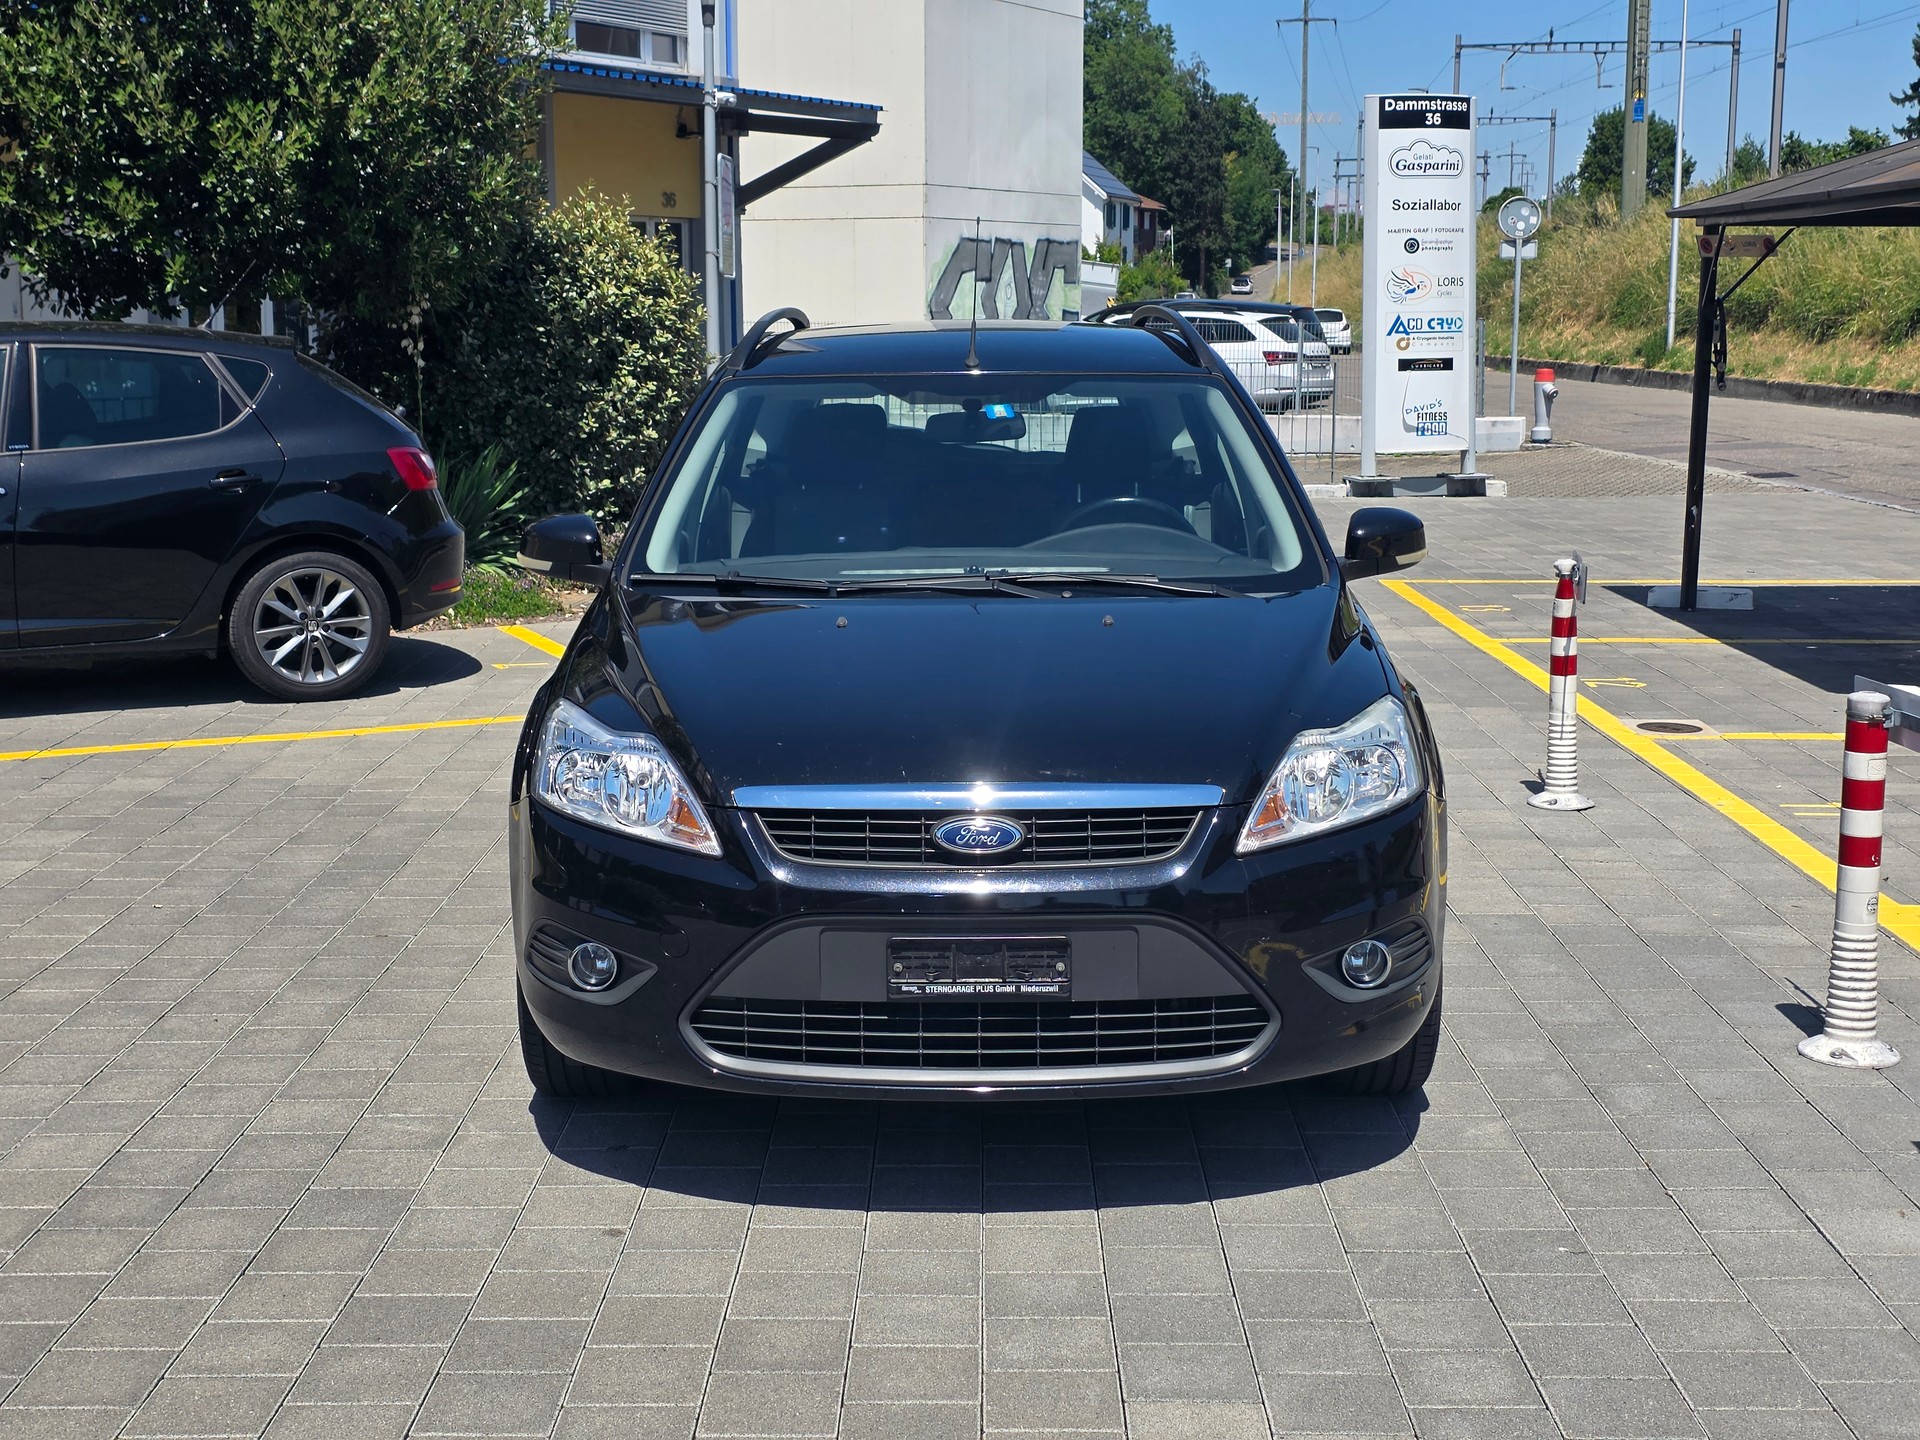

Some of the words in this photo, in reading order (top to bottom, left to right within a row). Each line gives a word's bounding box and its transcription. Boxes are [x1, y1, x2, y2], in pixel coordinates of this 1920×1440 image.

[1384, 98, 1468, 112] Dammstrasse
[1425, 113, 1442, 125] 36
[1395, 158, 1460, 173] Gasparini
[661, 191, 677, 209] 36
[1391, 198, 1462, 211] Soziallabor
[1437, 276, 1464, 287] LORIS
[1405, 398, 1443, 414] DAVID'S
[1417, 412, 1448, 422] FITNESS
[1418, 422, 1447, 436] FOOD
[956, 825, 1000, 846] Ford
[926, 986, 974, 994] STERNGARAGE
[1020, 984, 1059, 992] Niederuzwil
